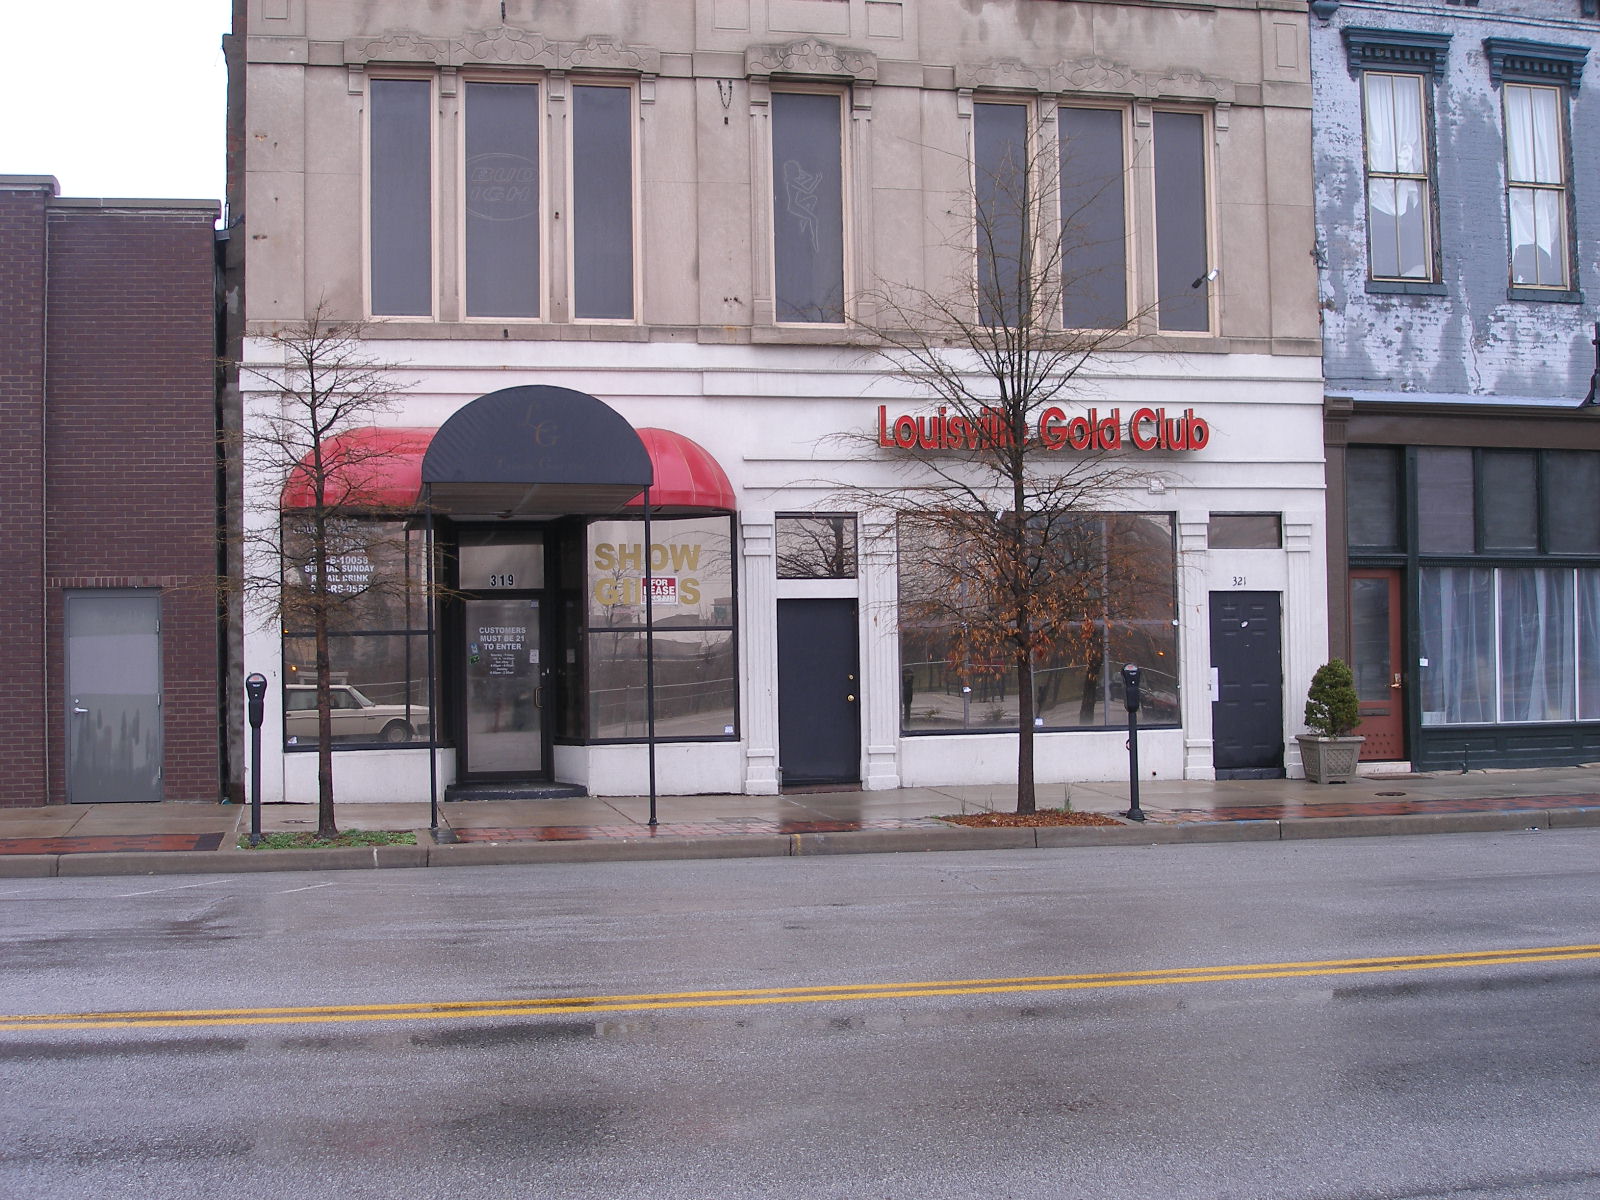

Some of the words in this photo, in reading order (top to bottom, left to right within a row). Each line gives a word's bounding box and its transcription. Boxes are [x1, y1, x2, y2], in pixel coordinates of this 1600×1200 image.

[1037, 406, 1121, 451] Gold
[1129, 406, 1210, 451] Club
[595, 543, 701, 570] SHOW
[304, 564, 340, 573] SPIAL
[341, 564, 375, 573] SUNDAY
[311, 574, 340, 582] RAIL
[490, 574, 514, 587] 319
[651, 579, 668, 587] FOR
[1232, 576, 1247, 587] 321
[594, 578, 700, 606] GIS
[480, 634, 502, 642] MUST
[503, 634, 515, 642] BE
[515, 634, 526, 642] 21
[483, 642, 495, 651] TO
[496, 642, 522, 651] ENTER
